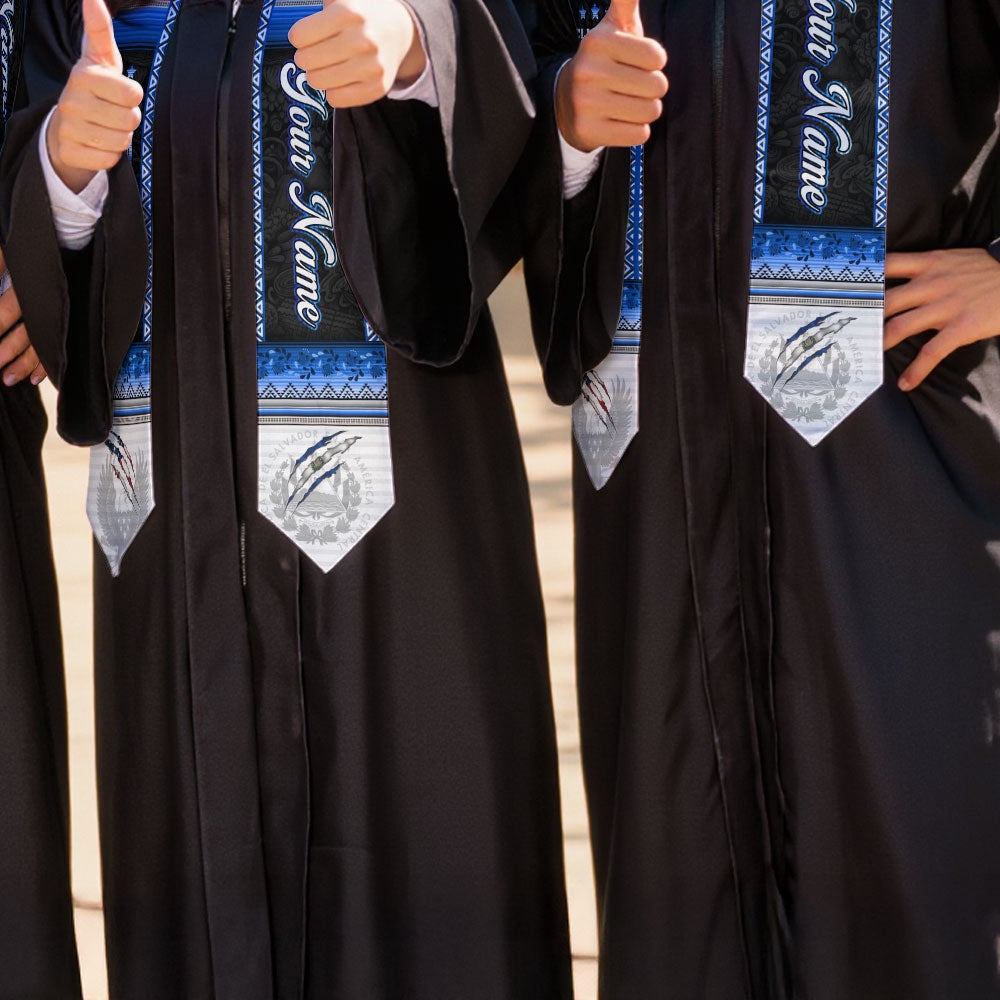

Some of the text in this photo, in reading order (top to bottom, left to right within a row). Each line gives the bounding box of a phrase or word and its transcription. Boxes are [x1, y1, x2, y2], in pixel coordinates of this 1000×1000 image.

[279, 61, 337, 330] Your Name
[798, 67, 853, 215] Name
